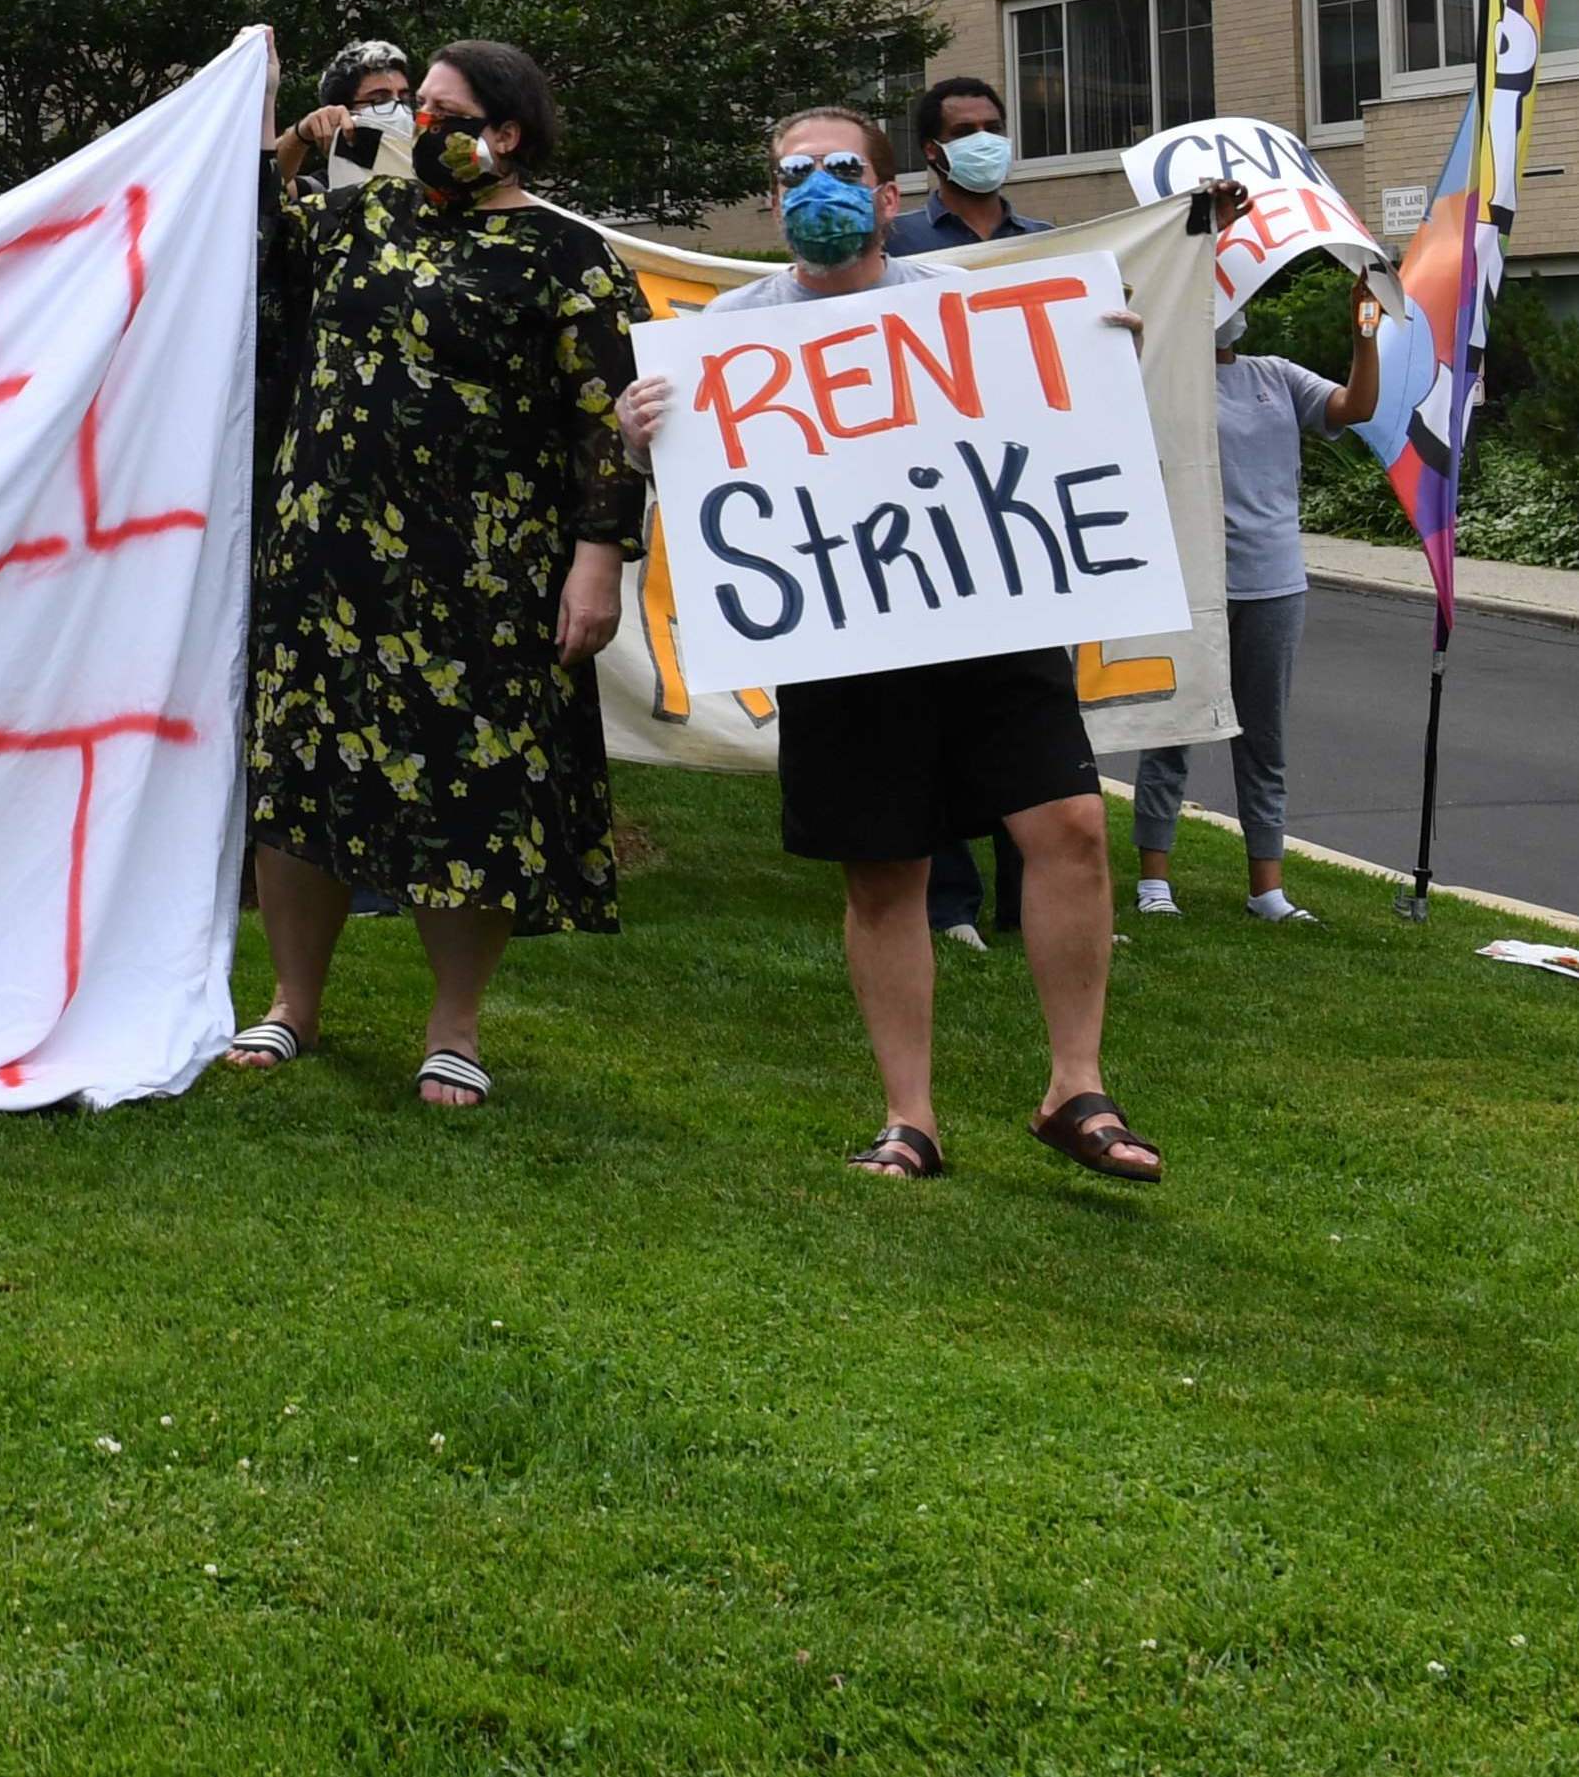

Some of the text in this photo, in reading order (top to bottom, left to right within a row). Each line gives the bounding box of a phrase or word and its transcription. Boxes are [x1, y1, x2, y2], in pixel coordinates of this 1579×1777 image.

[1385, 194, 1425, 208] FIRE LANE
[693, 276, 1089, 469] RENT
